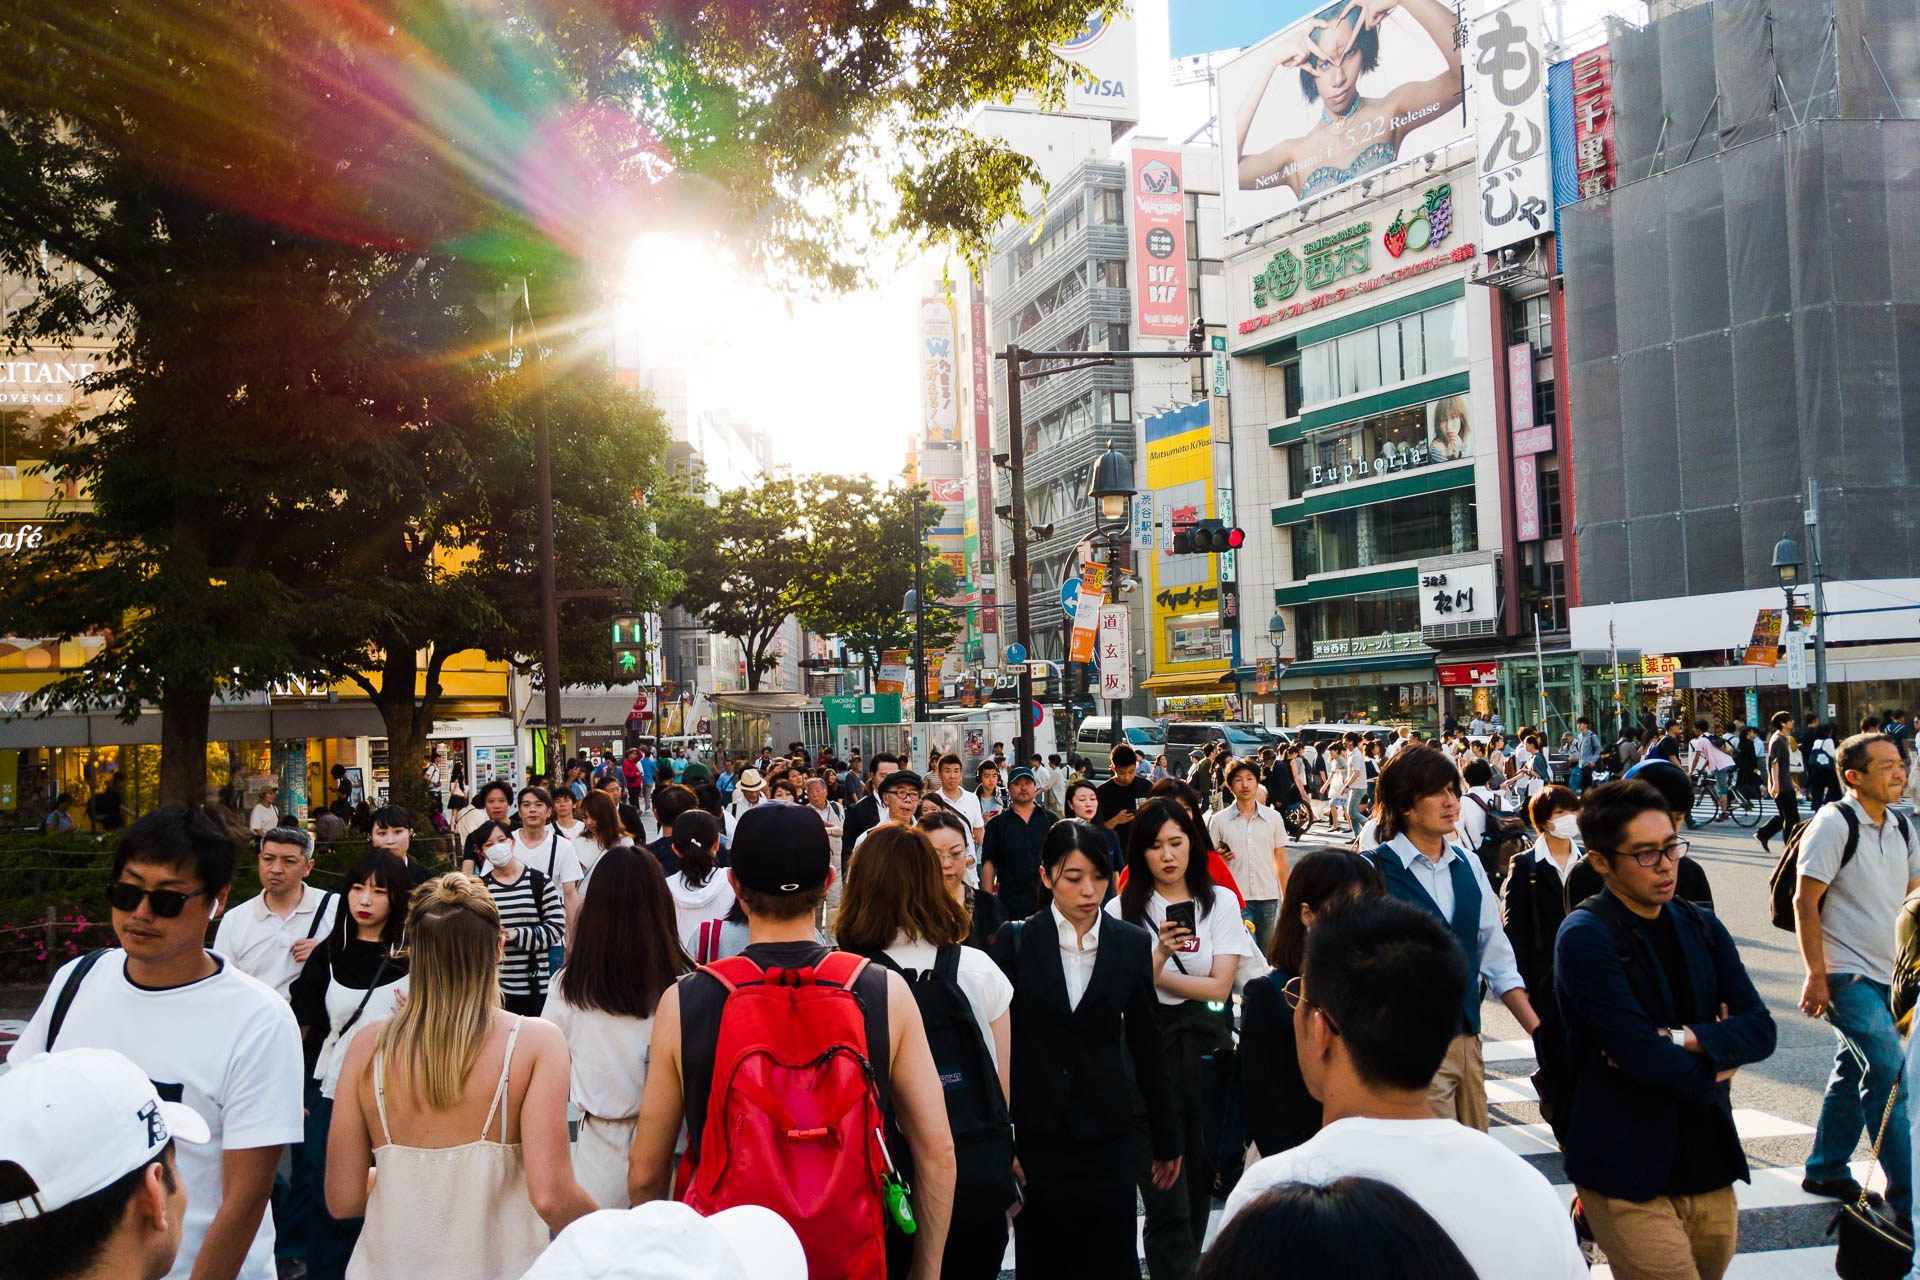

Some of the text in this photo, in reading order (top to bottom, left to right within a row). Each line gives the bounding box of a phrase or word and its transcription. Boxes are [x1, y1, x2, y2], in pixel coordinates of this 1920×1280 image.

[1083, 79, 1125, 98] VISA
[1476, 11, 1547, 231] もんじゃ
[1255, 171, 1280, 189] New
[1282, 154, 1318, 178] Album
[1346, 115, 1386, 147] 5.22
[1389, 101, 1441, 132] Release
[1303, 236, 1370, 290] 西村
[1149, 445, 1190, 461] Matsumoto
[1311, 446, 1422, 485] Euphoria
[1141, 494, 1151, 545] 渋谷駅前
[1519, 459, 1536, 538] もんじゃ焼
[1422, 573, 1447, 588] うなぎ
[1433, 587, 1474, 615] 松川
[1103, 614, 1120, 690] 道玄坂
[1315, 637, 1419, 655] 渋谷西村 フルーツパーラー
